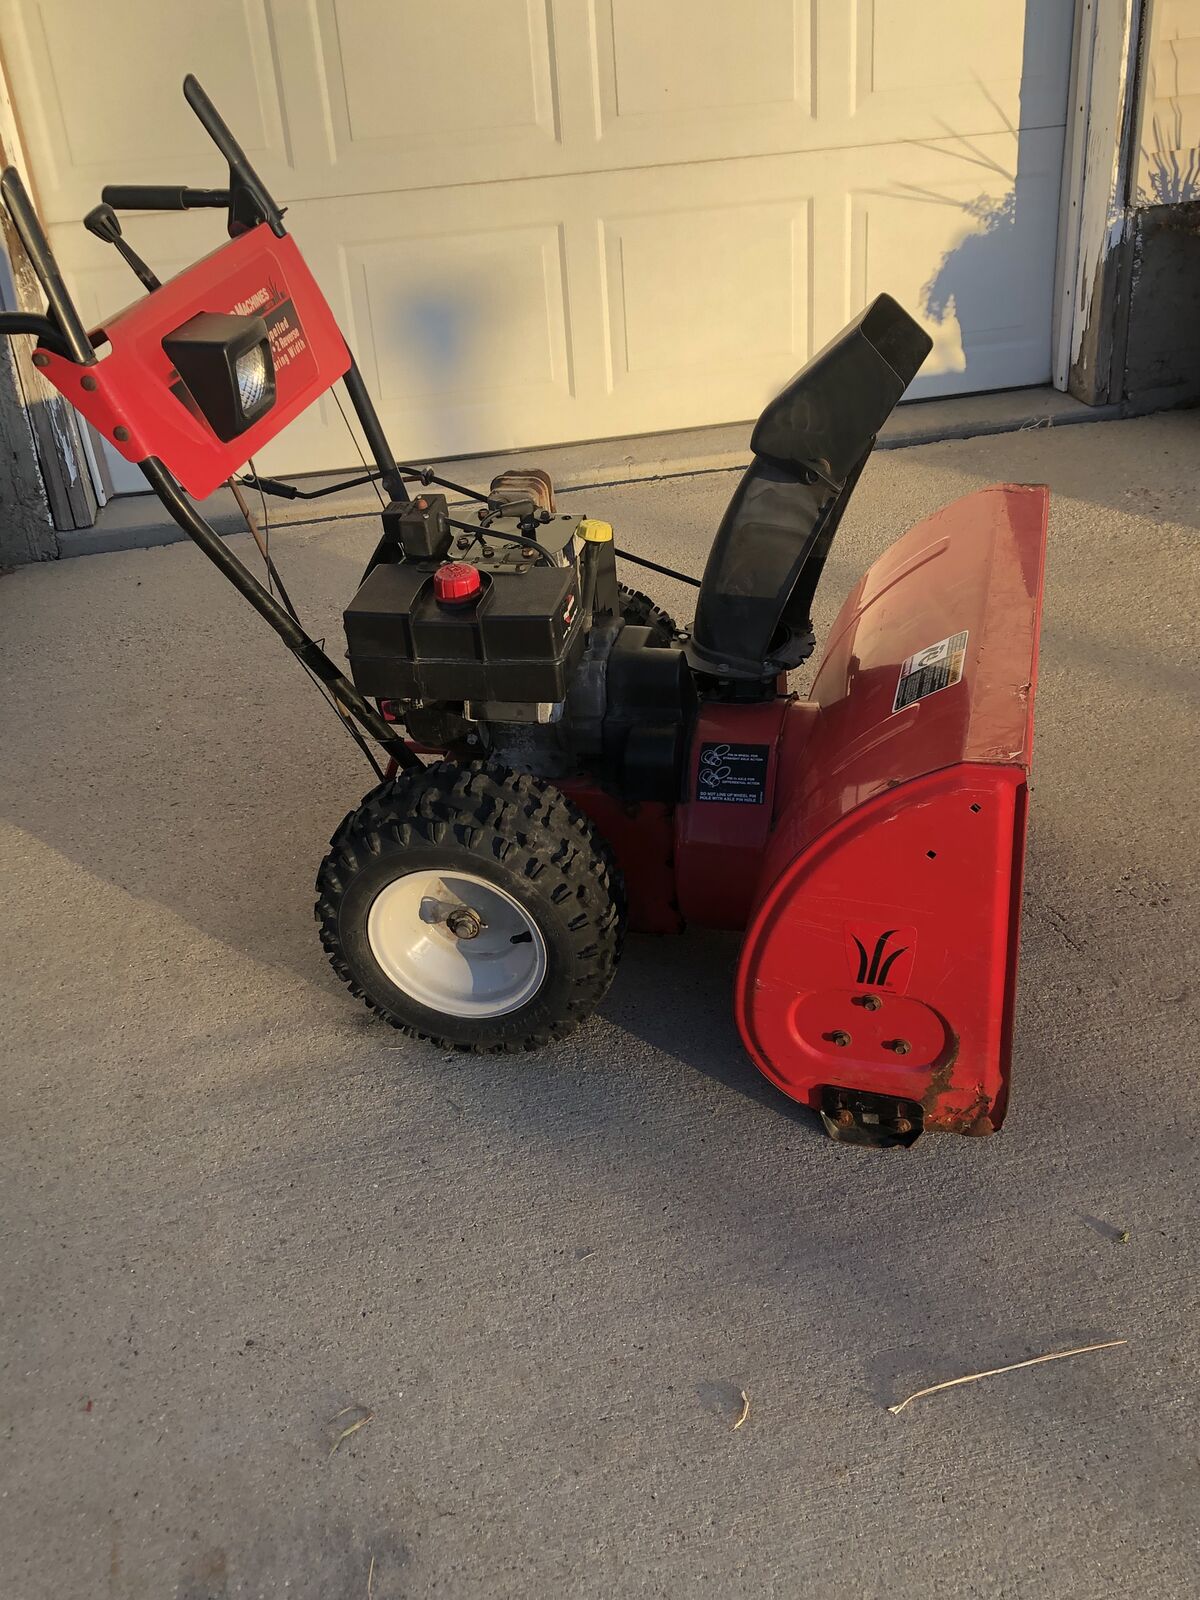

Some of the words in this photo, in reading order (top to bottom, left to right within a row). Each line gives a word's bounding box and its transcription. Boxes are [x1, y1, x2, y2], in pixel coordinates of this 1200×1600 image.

[234, 287, 270, 316] MACHINES
[268, 316, 290, 342] pelled
[274, 340, 282, 353] 2
[278, 327, 300, 349] Reverse
[287, 338, 306, 359] Width
